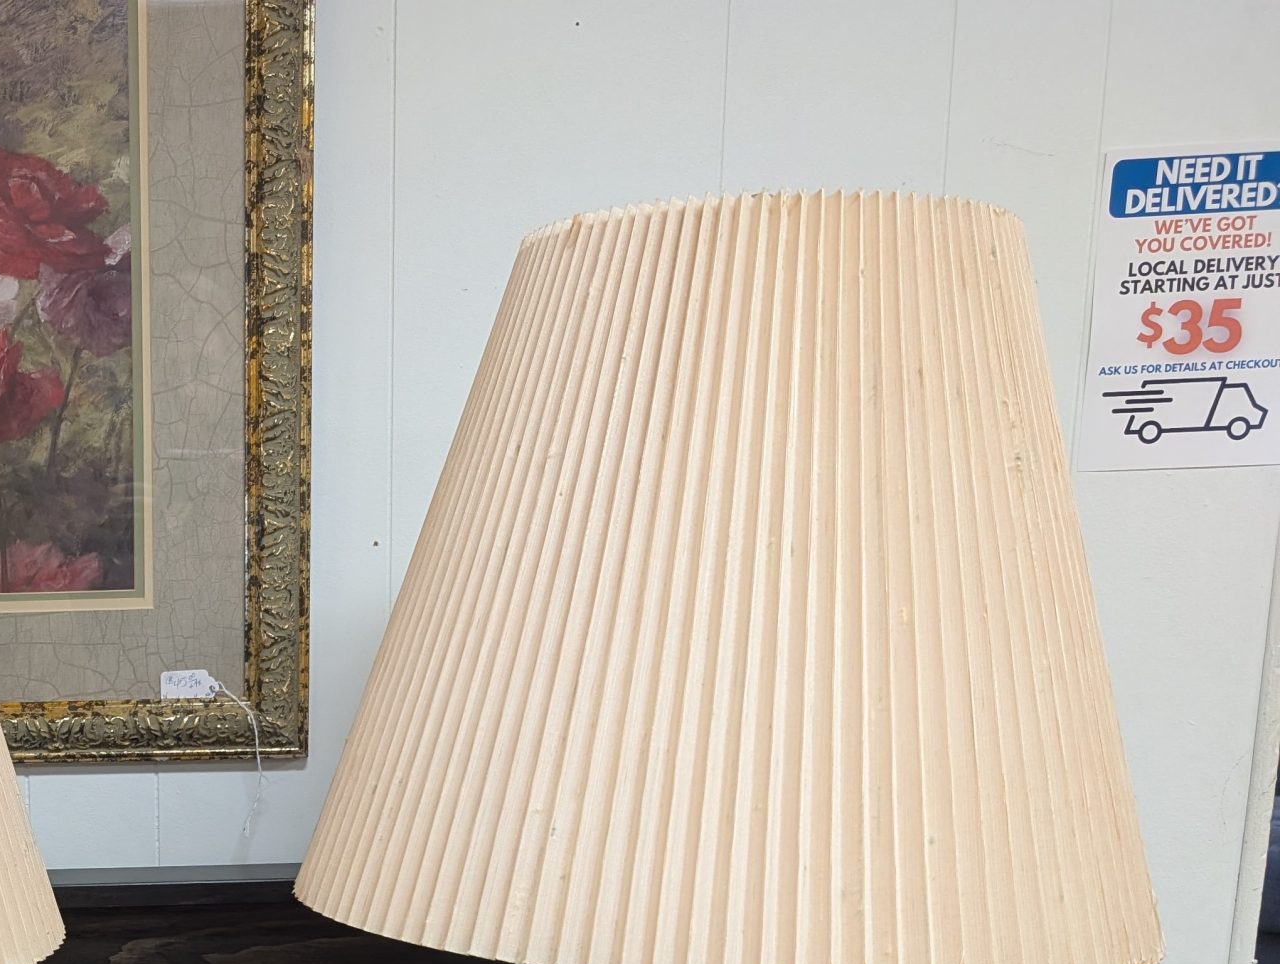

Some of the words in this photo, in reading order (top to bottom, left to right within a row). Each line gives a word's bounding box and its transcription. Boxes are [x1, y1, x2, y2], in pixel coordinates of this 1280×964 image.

[1155, 156, 1231, 185] NEED
[1236, 154, 1264, 181] IT
[1124, 181, 1280, 214] DELIVERED
[1154, 217, 1212, 235] WE'VE
[1217, 215, 1257, 232] GOT
[1135, 237, 1175, 254] YOU
[1180, 231, 1272, 252] COVERED!
[1128, 259, 1188, 277] LOCAL
[1193, 255, 1280, 274] DELIVERY
[1118, 276, 1210, 295] STARTING
[1214, 275, 1239, 290] AT
[1136, 298, 1242, 355] $35
[1098, 366, 1121, 376] ASK
[1124, 365, 1138, 375] US
[1141, 364, 1162, 374] FOR
[1164, 362, 1207, 373] DETAILS
[1208, 361, 1223, 371] AT
